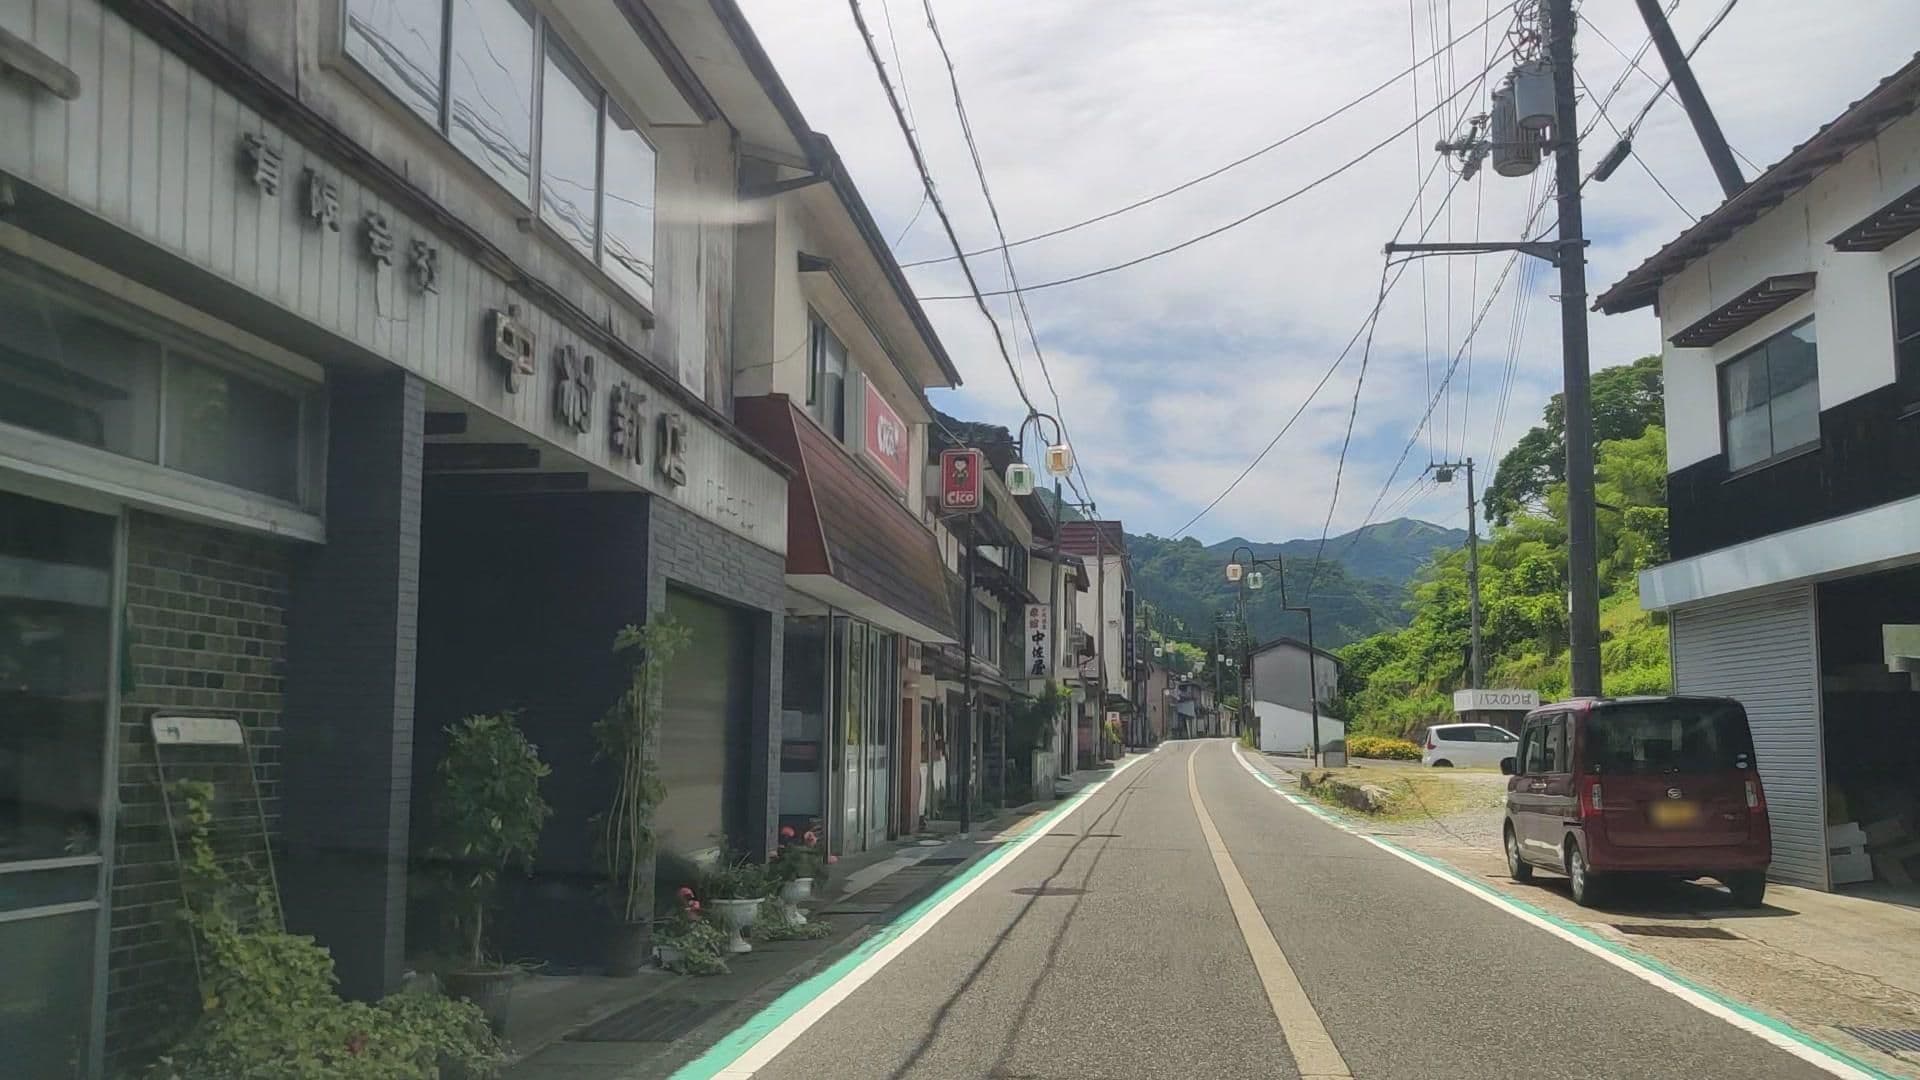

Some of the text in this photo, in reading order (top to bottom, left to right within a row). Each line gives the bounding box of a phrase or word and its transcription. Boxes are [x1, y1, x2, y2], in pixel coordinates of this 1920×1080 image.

[947, 491, 975, 505] Cico
[1031, 630, 1046, 676] 中佐屋
[1479, 693, 1533, 705] バスのりば
